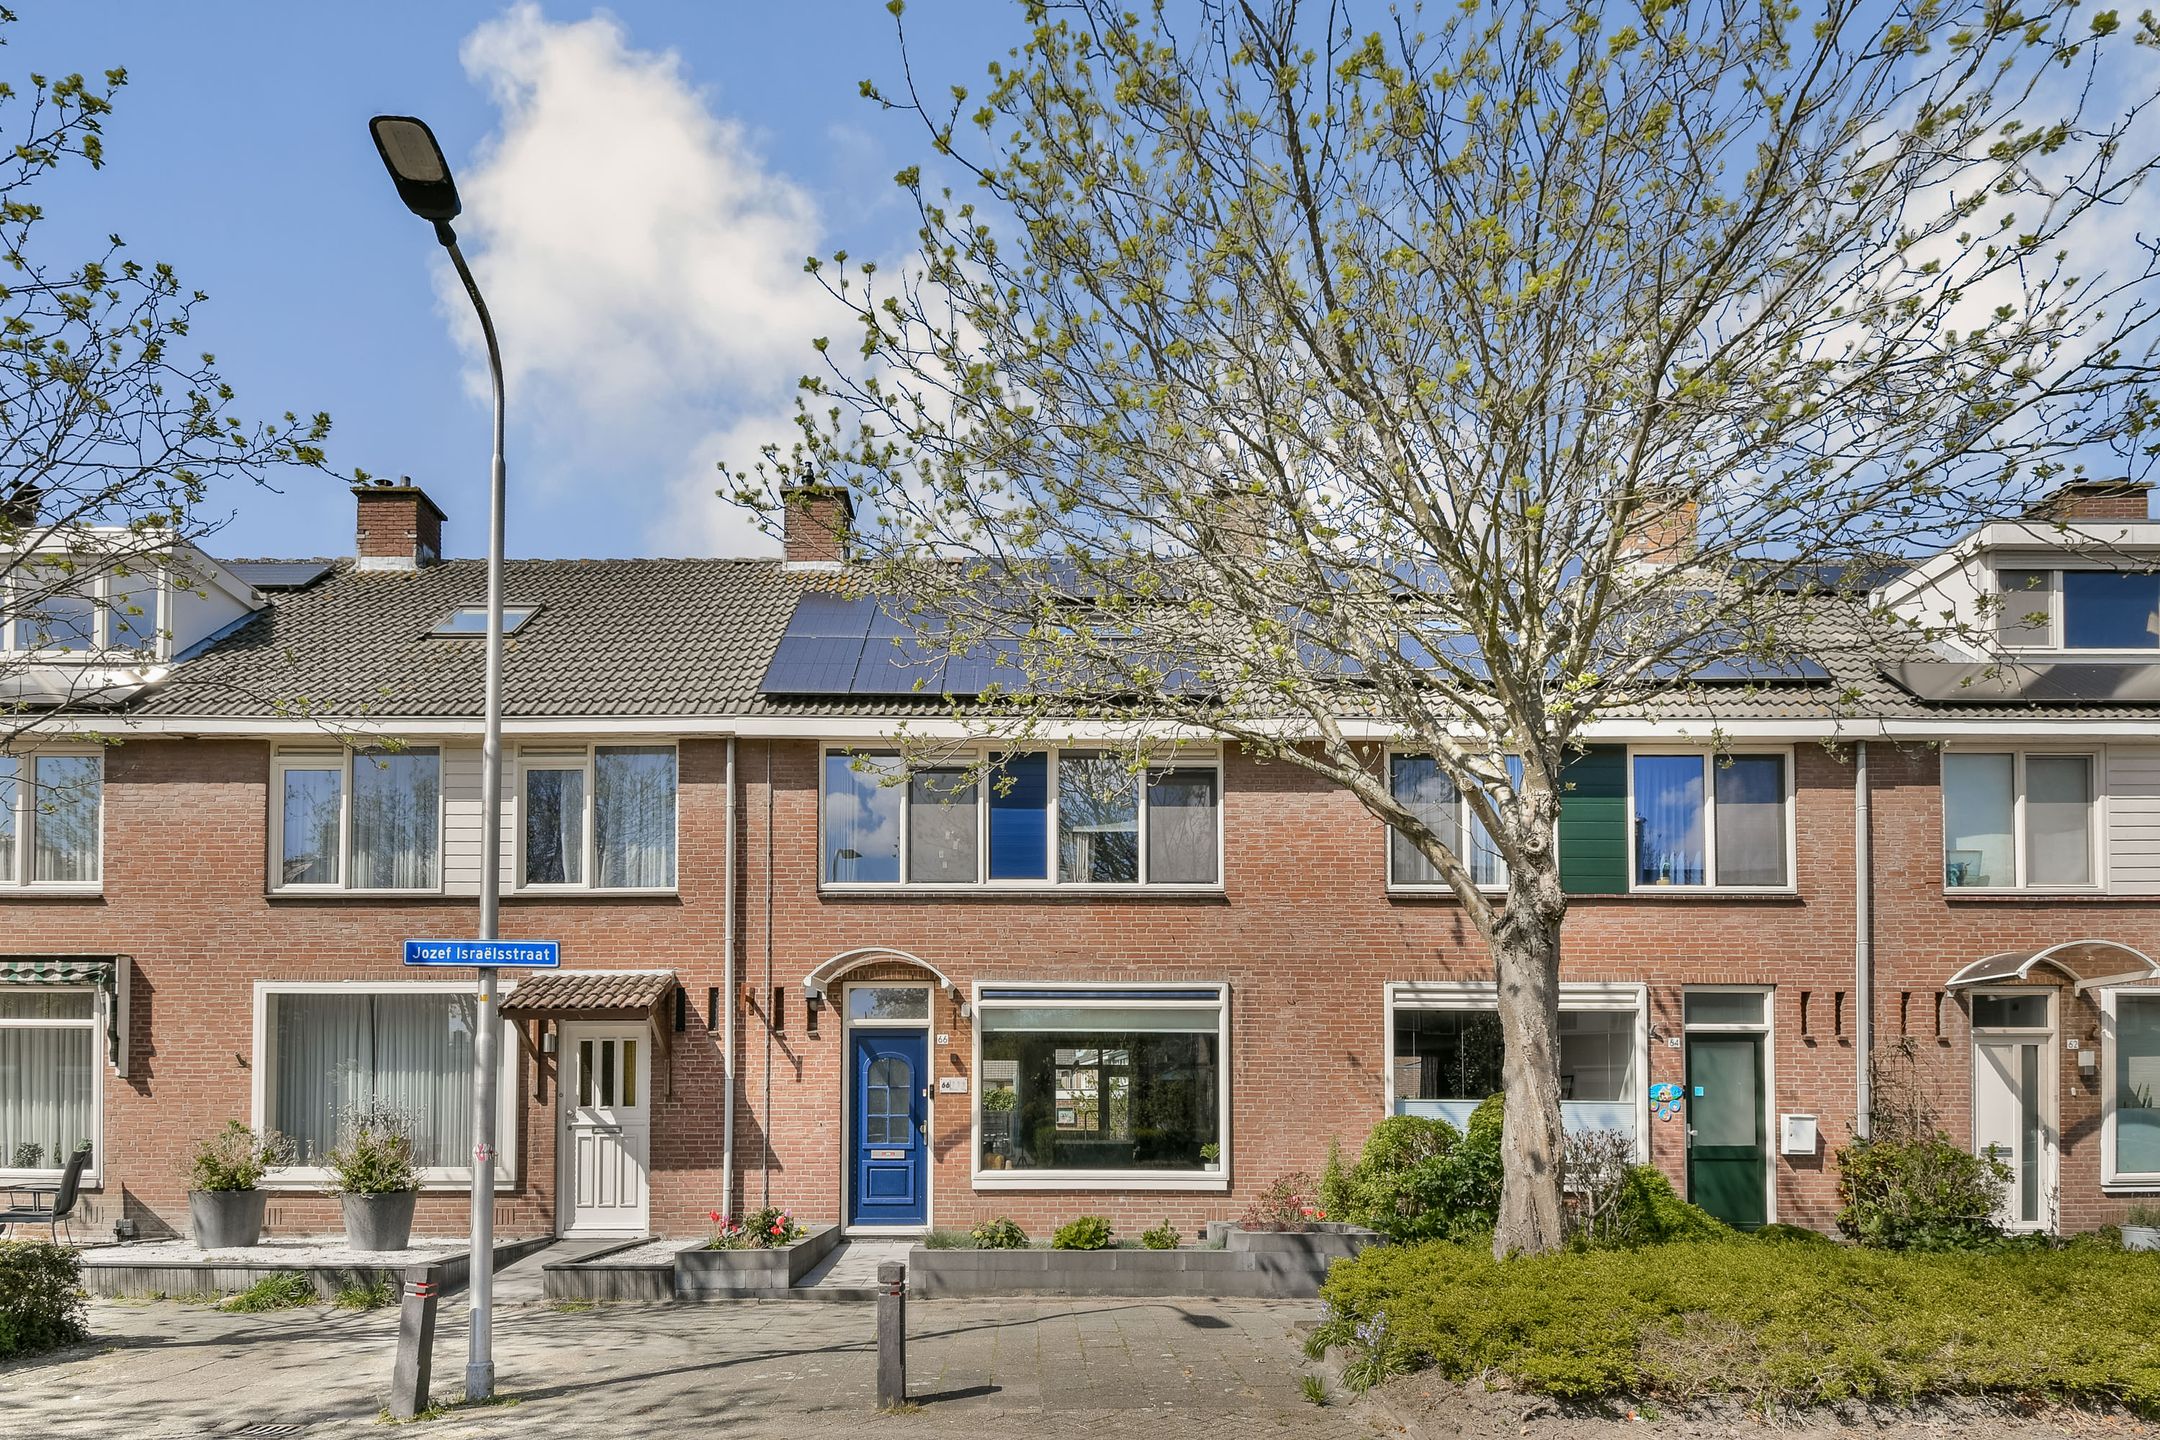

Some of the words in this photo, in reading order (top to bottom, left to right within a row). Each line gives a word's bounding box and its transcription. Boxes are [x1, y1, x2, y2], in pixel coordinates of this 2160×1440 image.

[412, 946, 452, 959] Jozef
[456, 947, 550, 961] Israëlsstraat
[938, 1035, 948, 1044] 66
[2068, 1040, 2078, 1049] 62
[941, 1081, 950, 1089] 66
